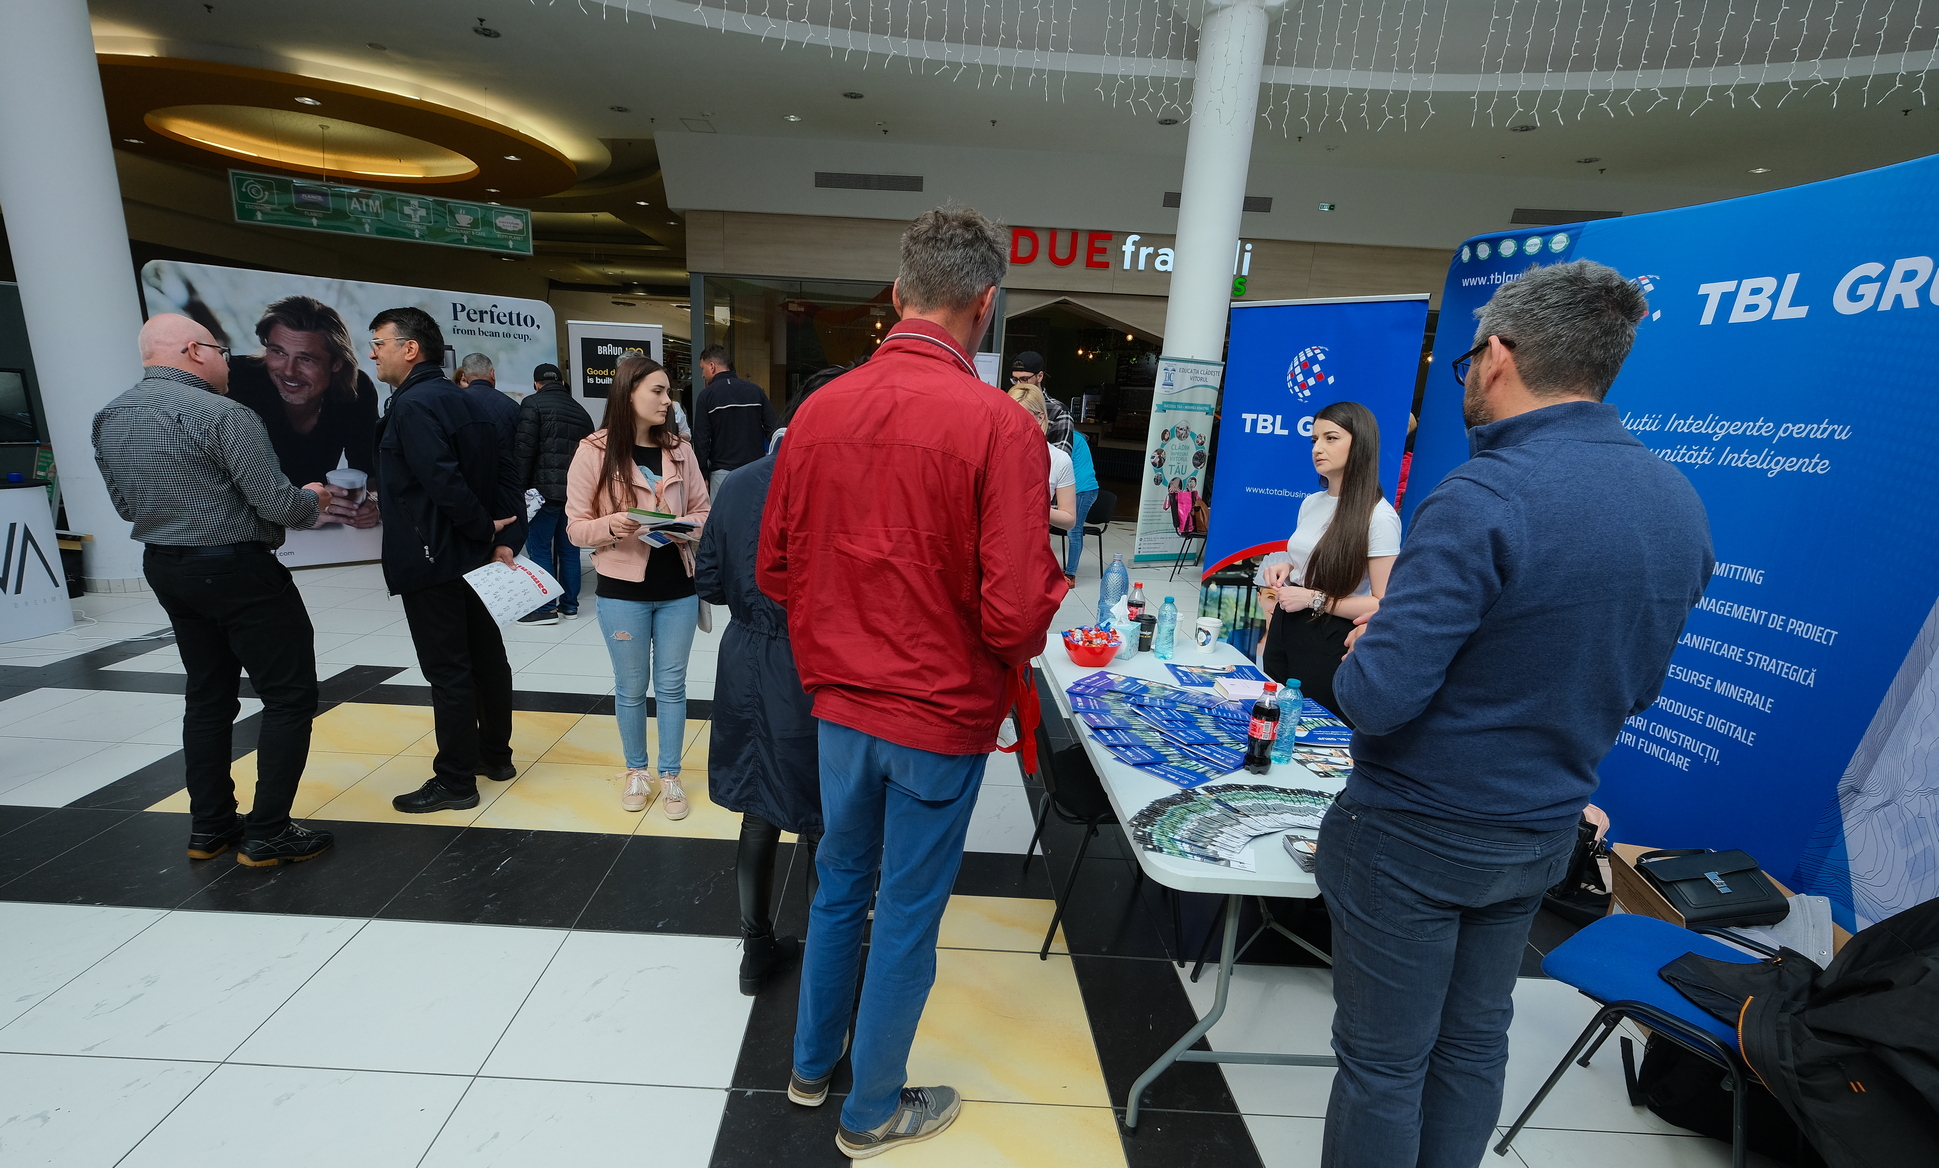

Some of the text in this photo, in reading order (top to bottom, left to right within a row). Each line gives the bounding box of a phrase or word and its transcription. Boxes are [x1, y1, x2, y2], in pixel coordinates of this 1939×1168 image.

[350, 197, 381, 213] ATM
[1009, 228, 1253, 276] DUE frali
[1697, 255, 1939, 326] TBL GR
[450, 301, 541, 331] Perfetto,
[452, 325, 532, 342] from bean to cup.
[586, 367, 609, 376] Good
[586, 376, 594, 384] is
[1241, 413, 1314, 438] TBL G
[1620, 411, 1853, 444] luții Inteligente pentru
[1168, 462, 1187, 475] TĂU
[1717, 446, 1832, 478] Inteligente
[1245, 486, 1312, 499] www.totalbusine
[1712, 561, 1765, 585] MITTING
[1694, 595, 1839, 647] NAGEMENT DE PROIECT
[1677, 632, 1818, 688] LANIFICARE STRATEGICĂ
[1666, 664, 1775, 714] ESURSE MINERALE
[1648, 722, 1720, 766] CONSTRUCȚII,
[1705, 714, 1757, 747] DIGITALE
[1637, 738, 1692, 772] FUNCIARE
